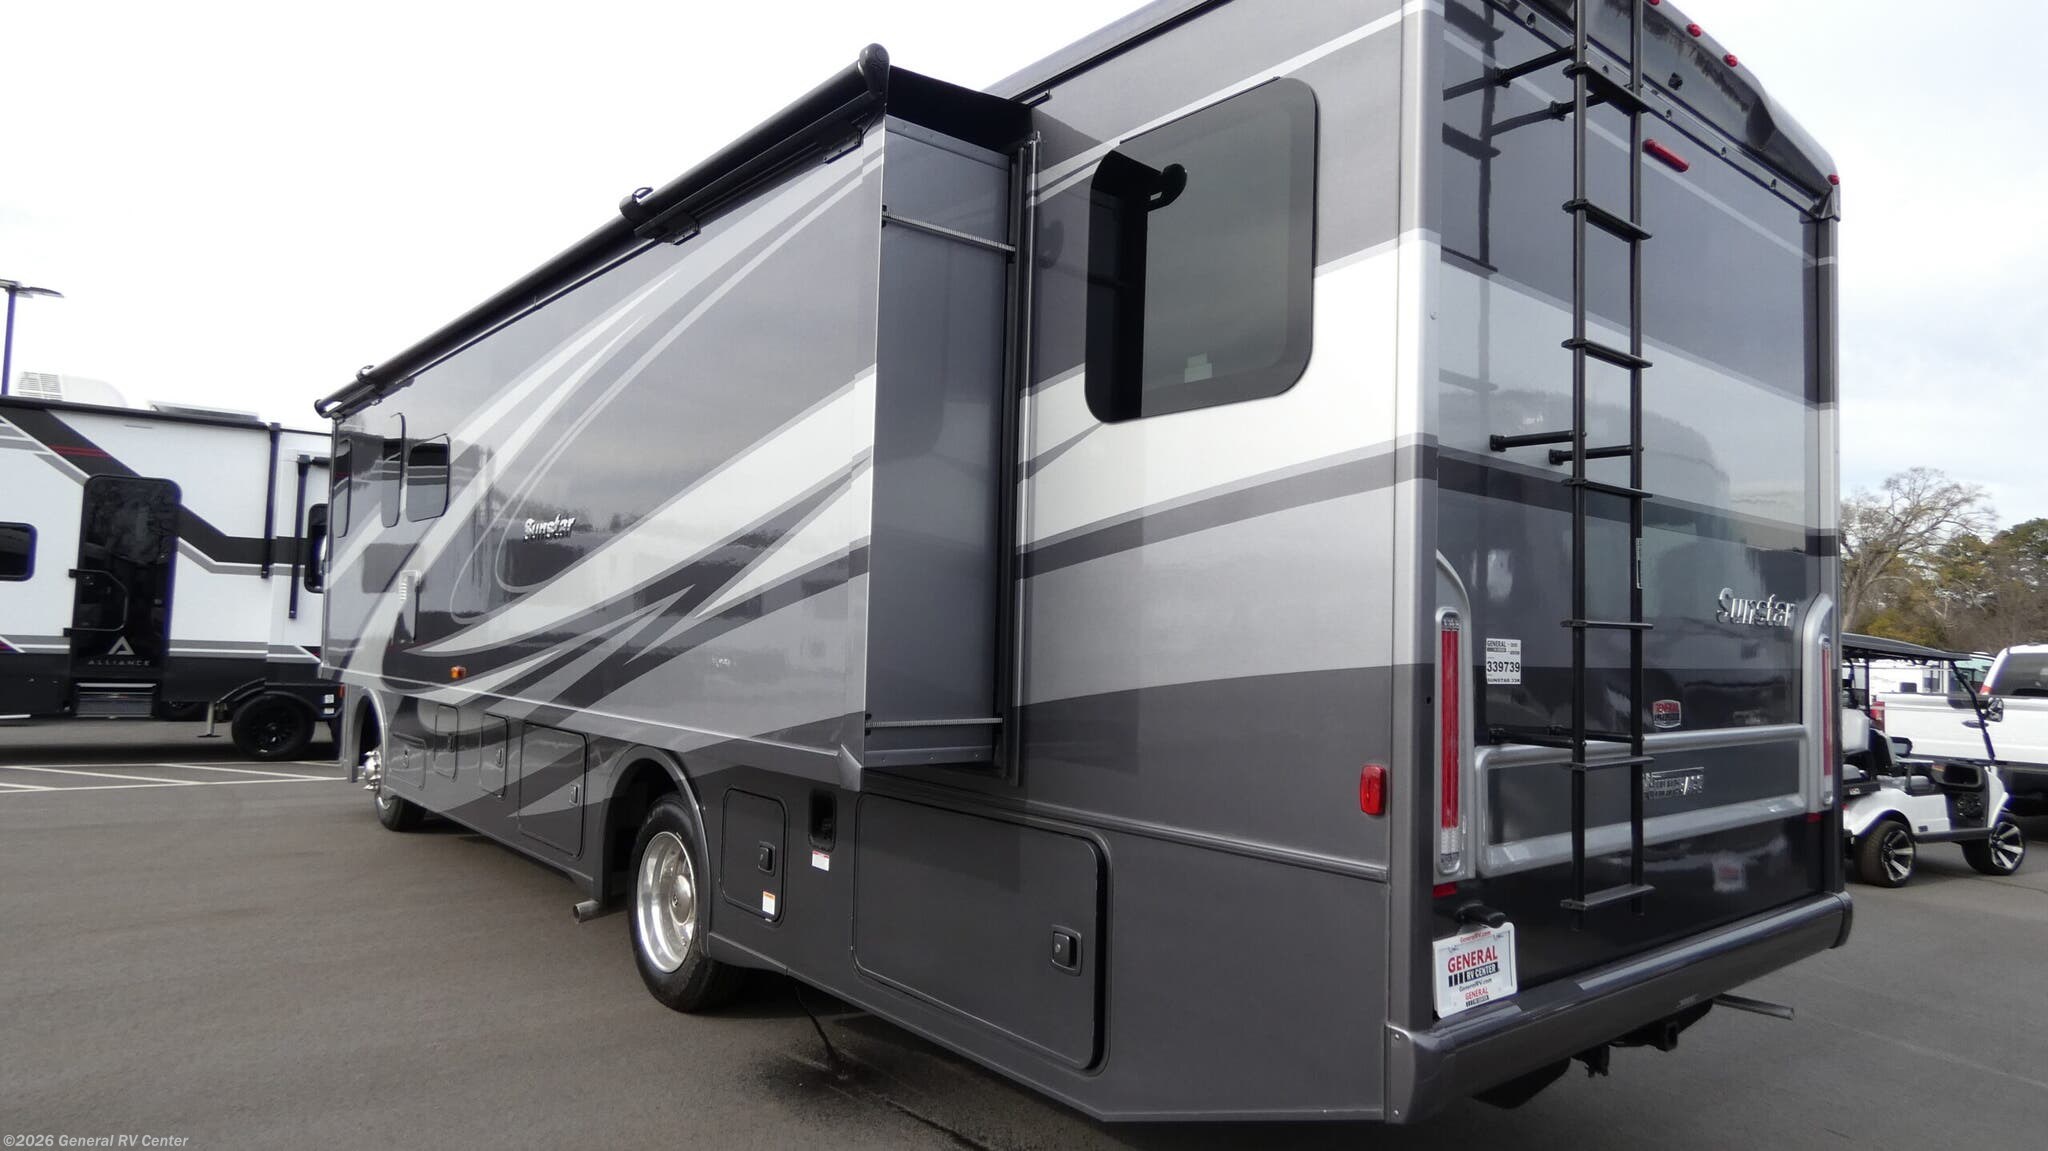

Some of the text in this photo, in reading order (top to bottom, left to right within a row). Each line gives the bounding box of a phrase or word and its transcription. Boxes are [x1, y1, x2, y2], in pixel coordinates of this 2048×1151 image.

[524, 513, 576, 541] Sunstar
[1716, 587, 1796, 627] Sunstar
[1487, 661, 1520, 673] 339739
[1447, 946, 1498, 973] GENERAL
[1465, 965, 1497, 981] RV CENTER
[1465, 988, 1488, 1000] GENERAL
